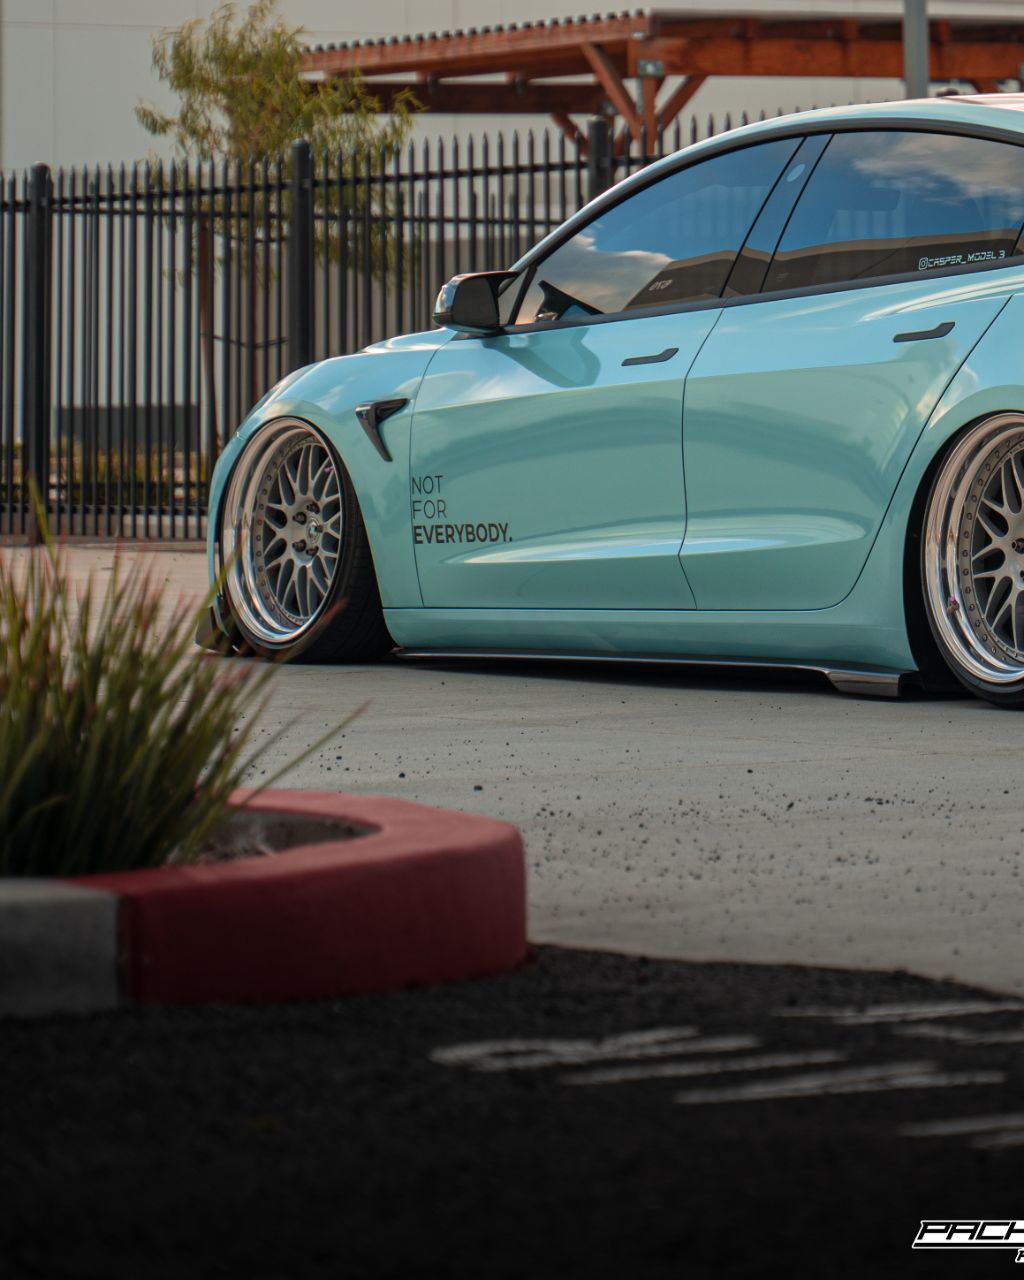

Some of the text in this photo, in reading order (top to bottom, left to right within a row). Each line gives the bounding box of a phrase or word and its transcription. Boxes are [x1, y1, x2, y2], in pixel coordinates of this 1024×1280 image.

[412, 475, 444, 495] NOT
[412, 499, 447, 519] FOR
[413, 522, 512, 544] EVERYBODY.
